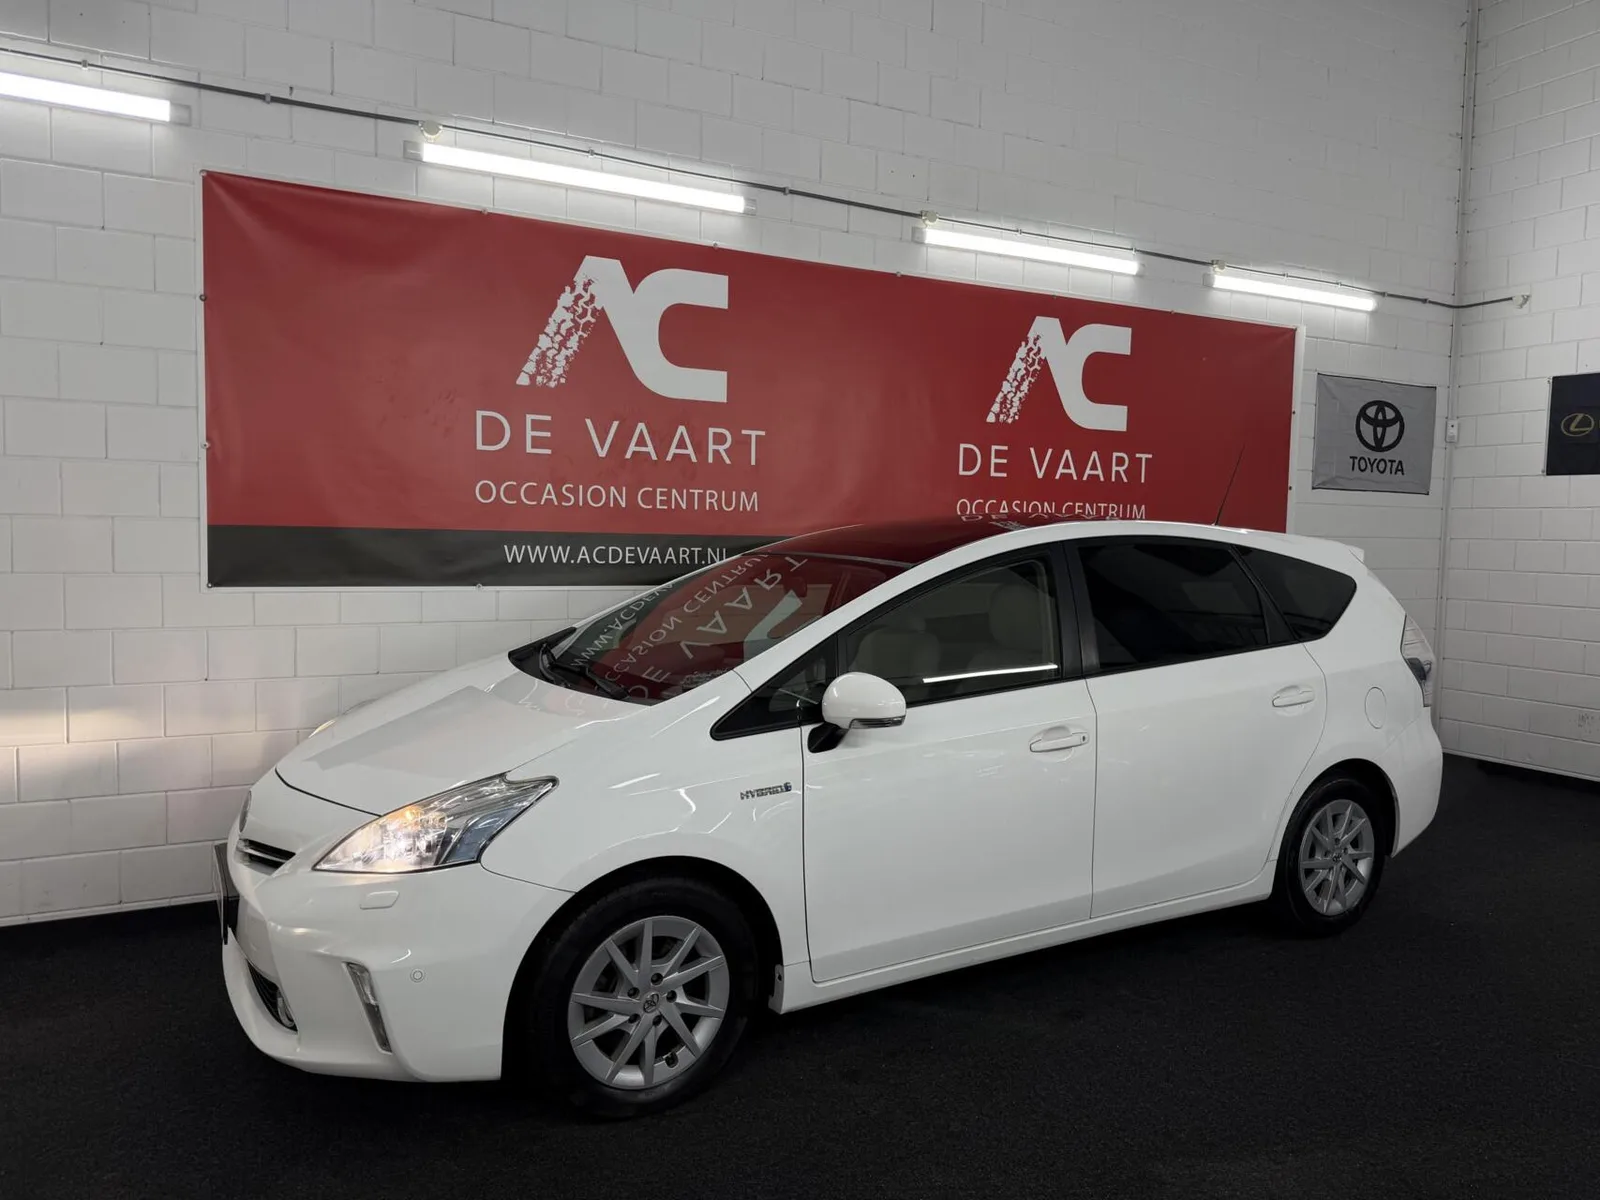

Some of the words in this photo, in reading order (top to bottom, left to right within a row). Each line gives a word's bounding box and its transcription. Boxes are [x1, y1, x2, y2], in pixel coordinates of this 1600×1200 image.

[516, 255, 729, 403] AC
[986, 316, 1132, 432] AC
[475, 410, 552, 455] DE
[585, 418, 766, 466] VAART
[958, 443, 1009, 478] DE
[1029, 447, 1152, 483] VAART
[1349, 456, 1404, 476] TOYOTA
[475, 480, 627, 508] OCCASION
[637, 487, 759, 512] CENTRUM
[956, 499, 1055, 515] OCCASION
[1062, 502, 1146, 519] CENTRUM
